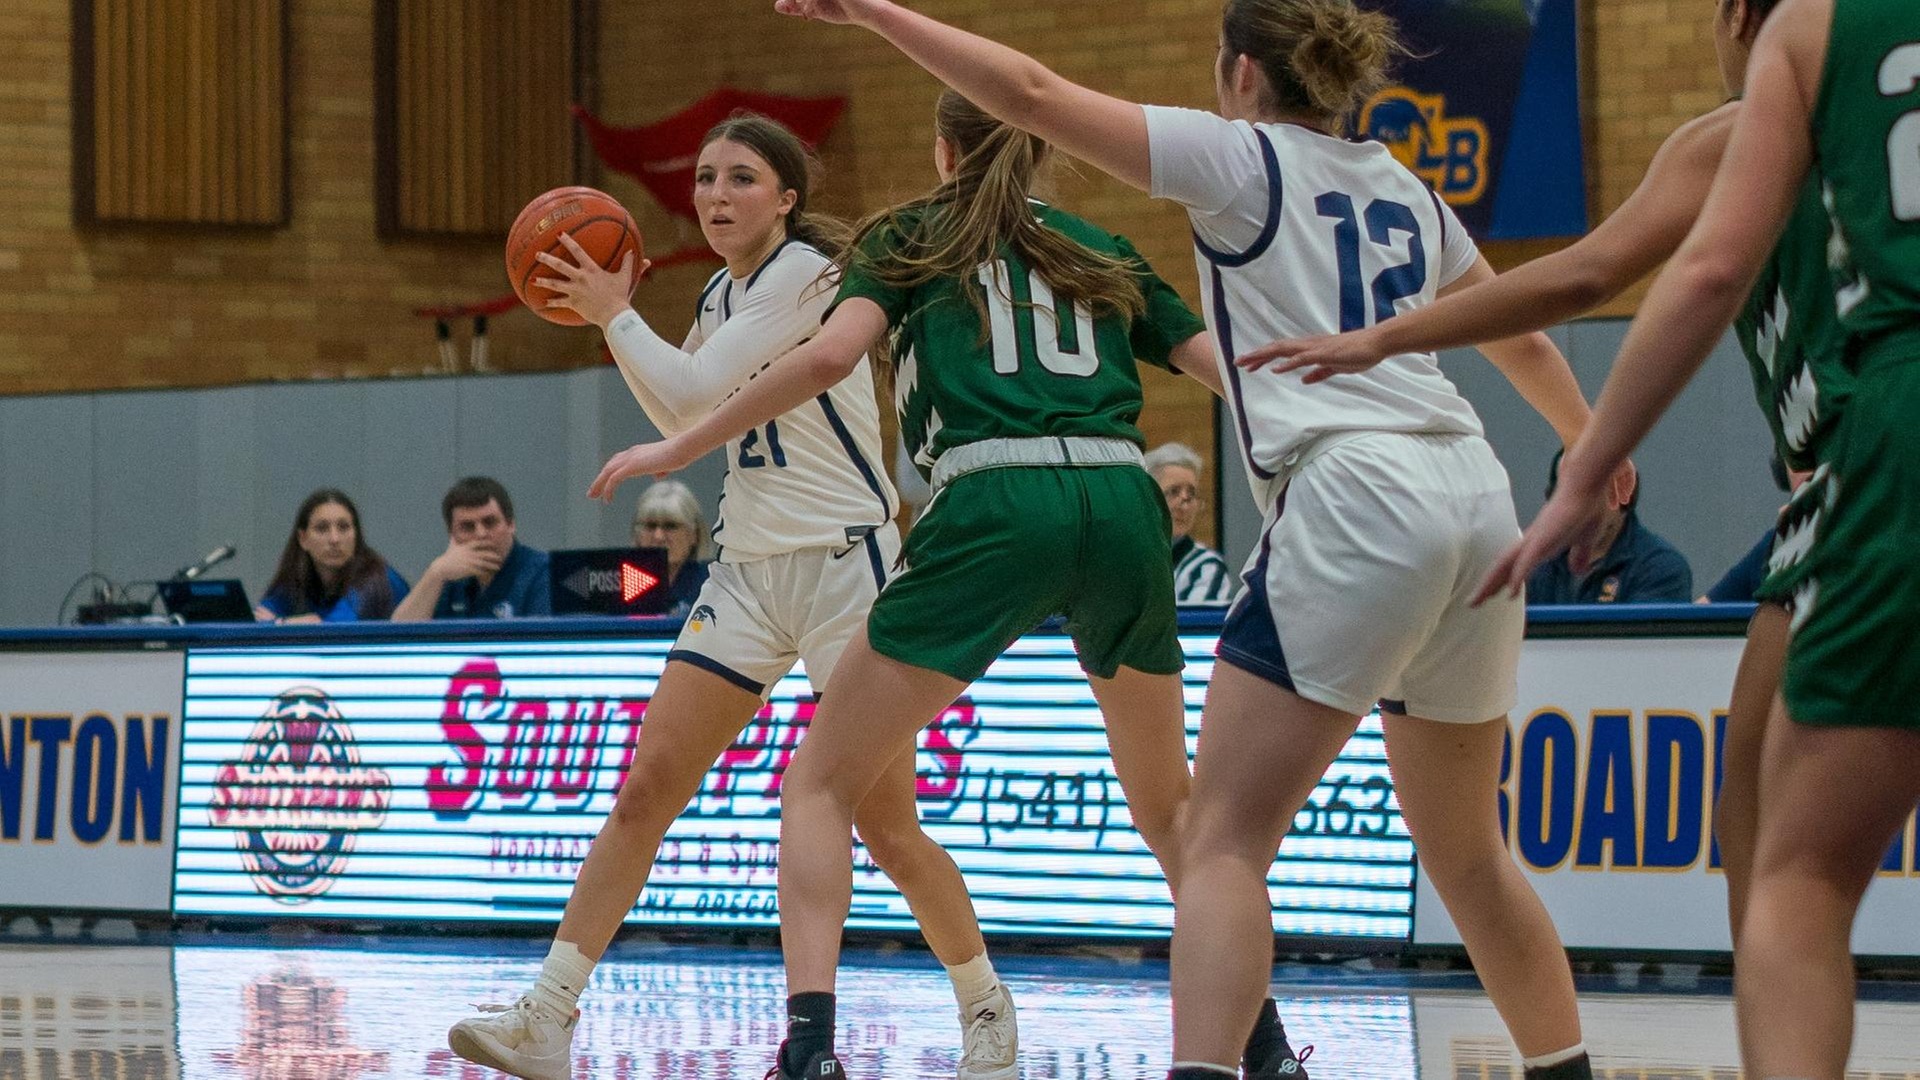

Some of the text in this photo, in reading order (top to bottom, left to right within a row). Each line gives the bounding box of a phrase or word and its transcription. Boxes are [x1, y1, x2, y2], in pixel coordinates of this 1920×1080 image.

[1314, 190, 1427, 334] 12
[977, 258, 1100, 377] 10
[588, 569, 622, 592] POSS
[820, 1059, 838, 1076] GT
